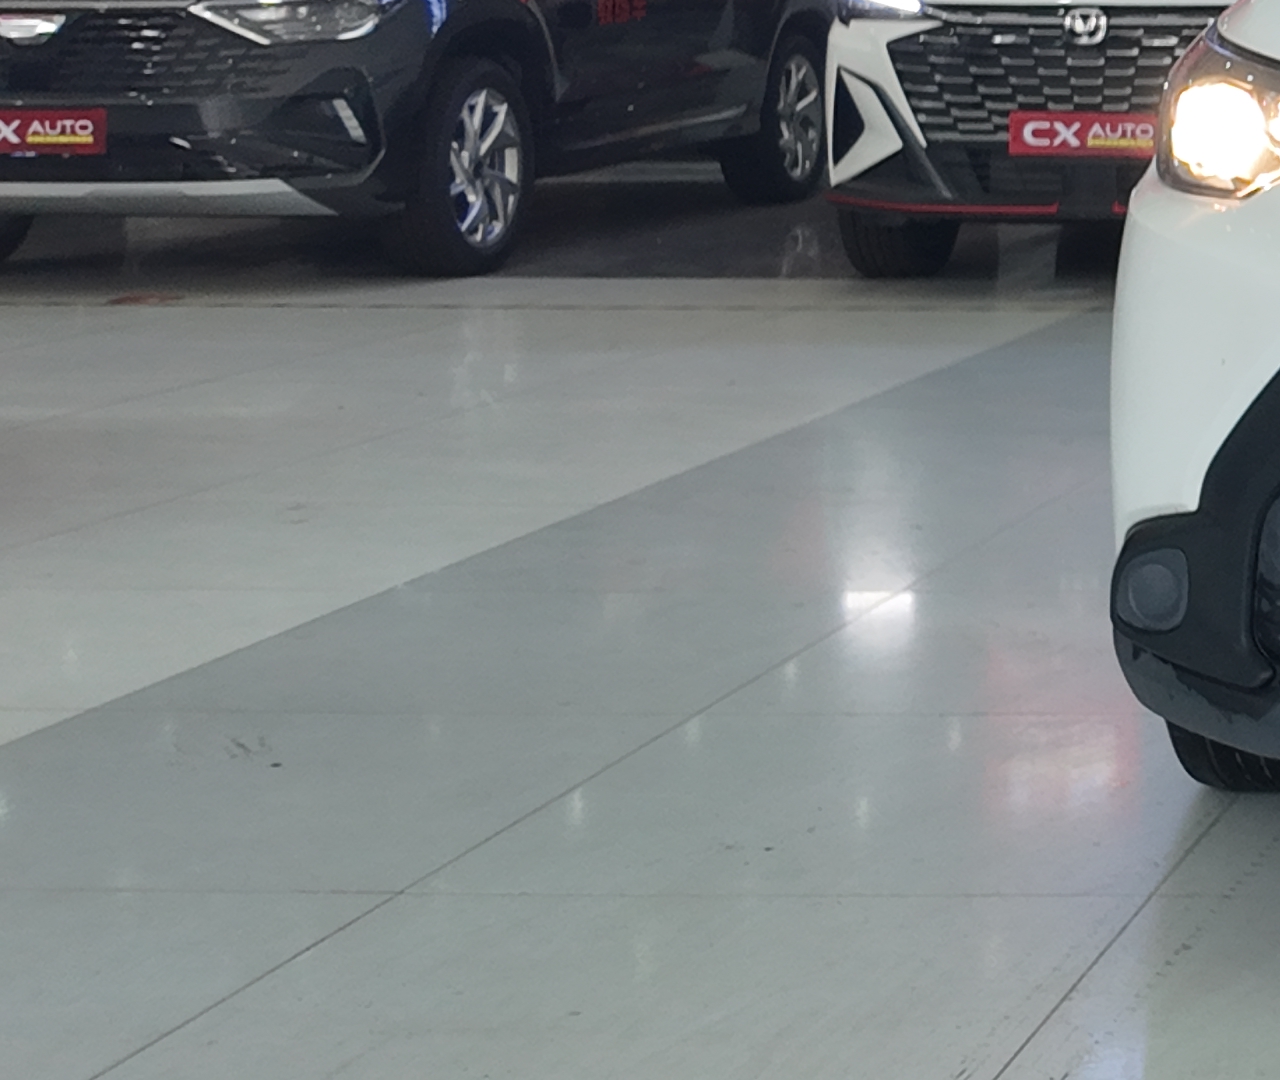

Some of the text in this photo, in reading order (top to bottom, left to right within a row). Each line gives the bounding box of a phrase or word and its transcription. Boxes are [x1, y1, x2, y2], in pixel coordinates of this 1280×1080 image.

[26, 119, 94, 136] AUTO
[1022, 120, 1081, 147] CX
[1087, 122, 1154, 139] AUTO
